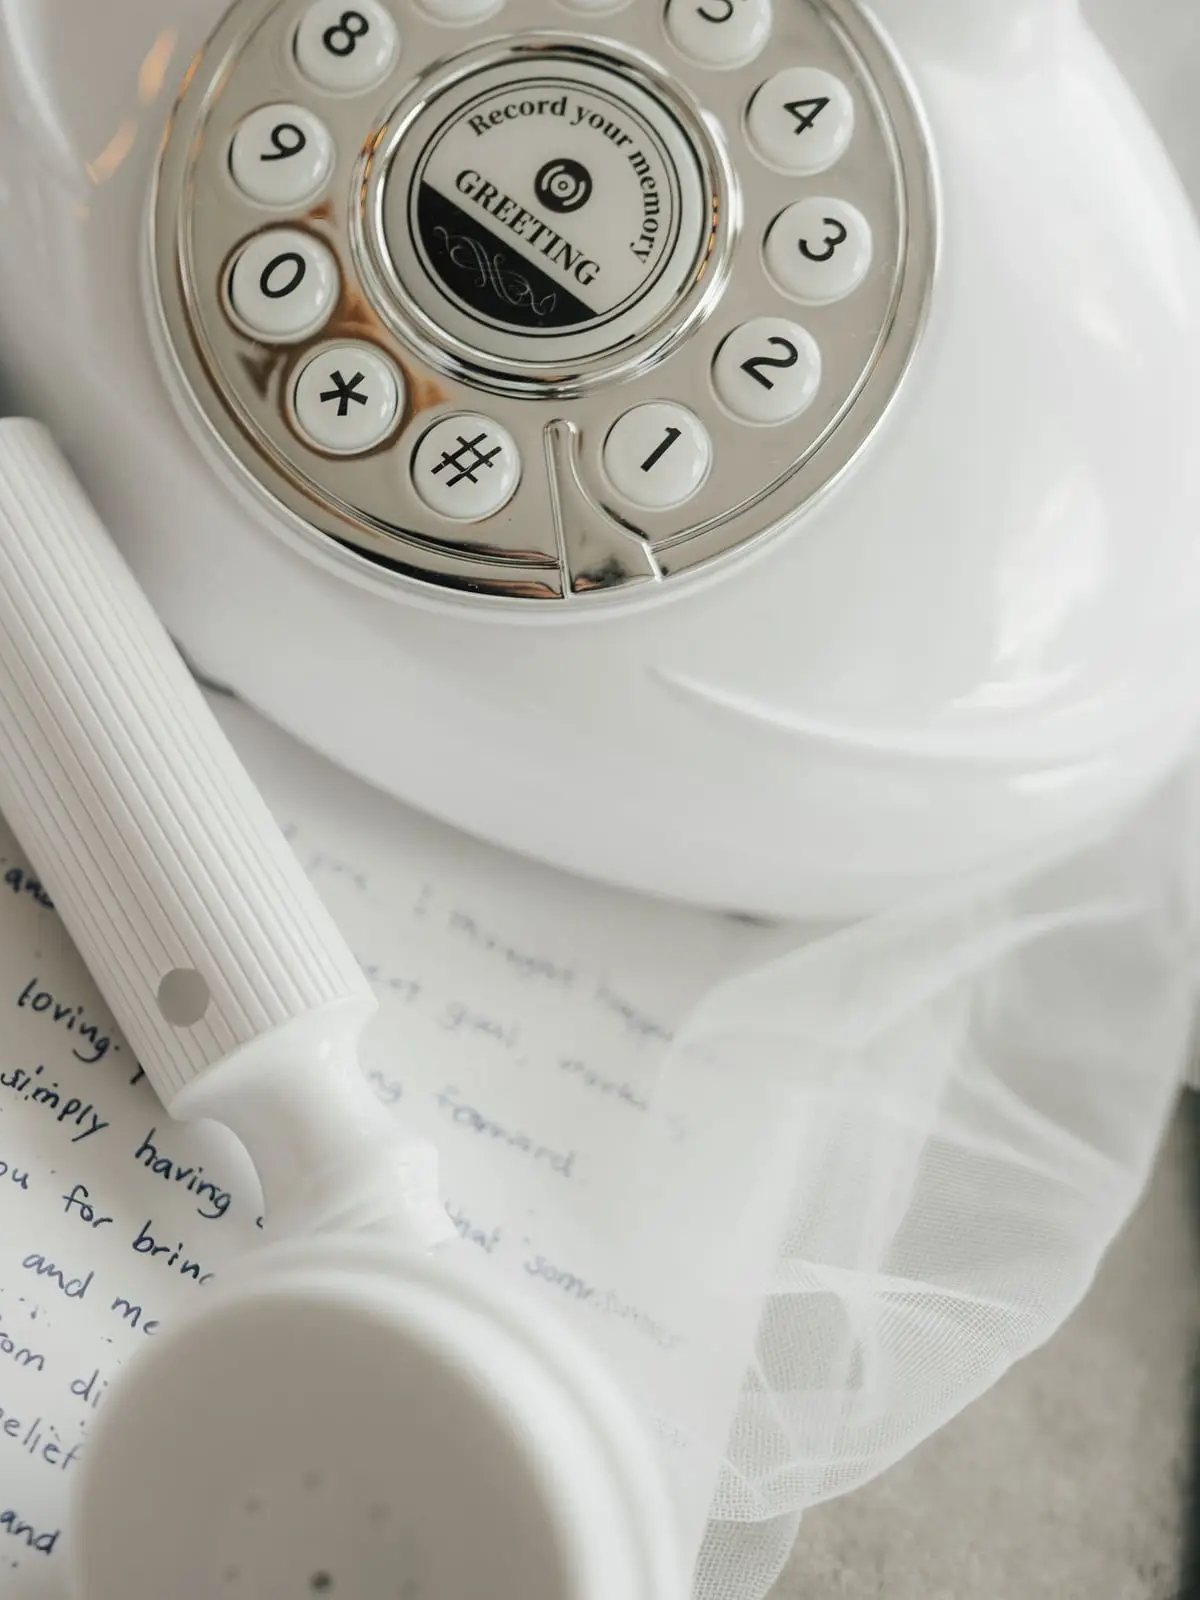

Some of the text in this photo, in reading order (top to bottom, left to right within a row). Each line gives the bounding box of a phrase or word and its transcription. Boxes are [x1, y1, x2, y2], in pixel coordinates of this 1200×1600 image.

[322, 11, 369, 57] 8
[781, 95, 831, 136] 4
[259, 123, 307, 165] 9
[467, 97, 661, 264] Record your memory
[455, 169, 601, 286] GREETING
[797, 217, 847, 263] 3
[259, 251, 307, 299] 0
[740, 337, 799, 391] 2
[640, 426, 682, 473] 1
[1, 1065, 109, 1142] simply
[134, 1127, 232, 1219] having
[62, 1184, 113, 1228] for
[22, 1254, 94, 1299] and
[0, 1508, 60, 1556] and
